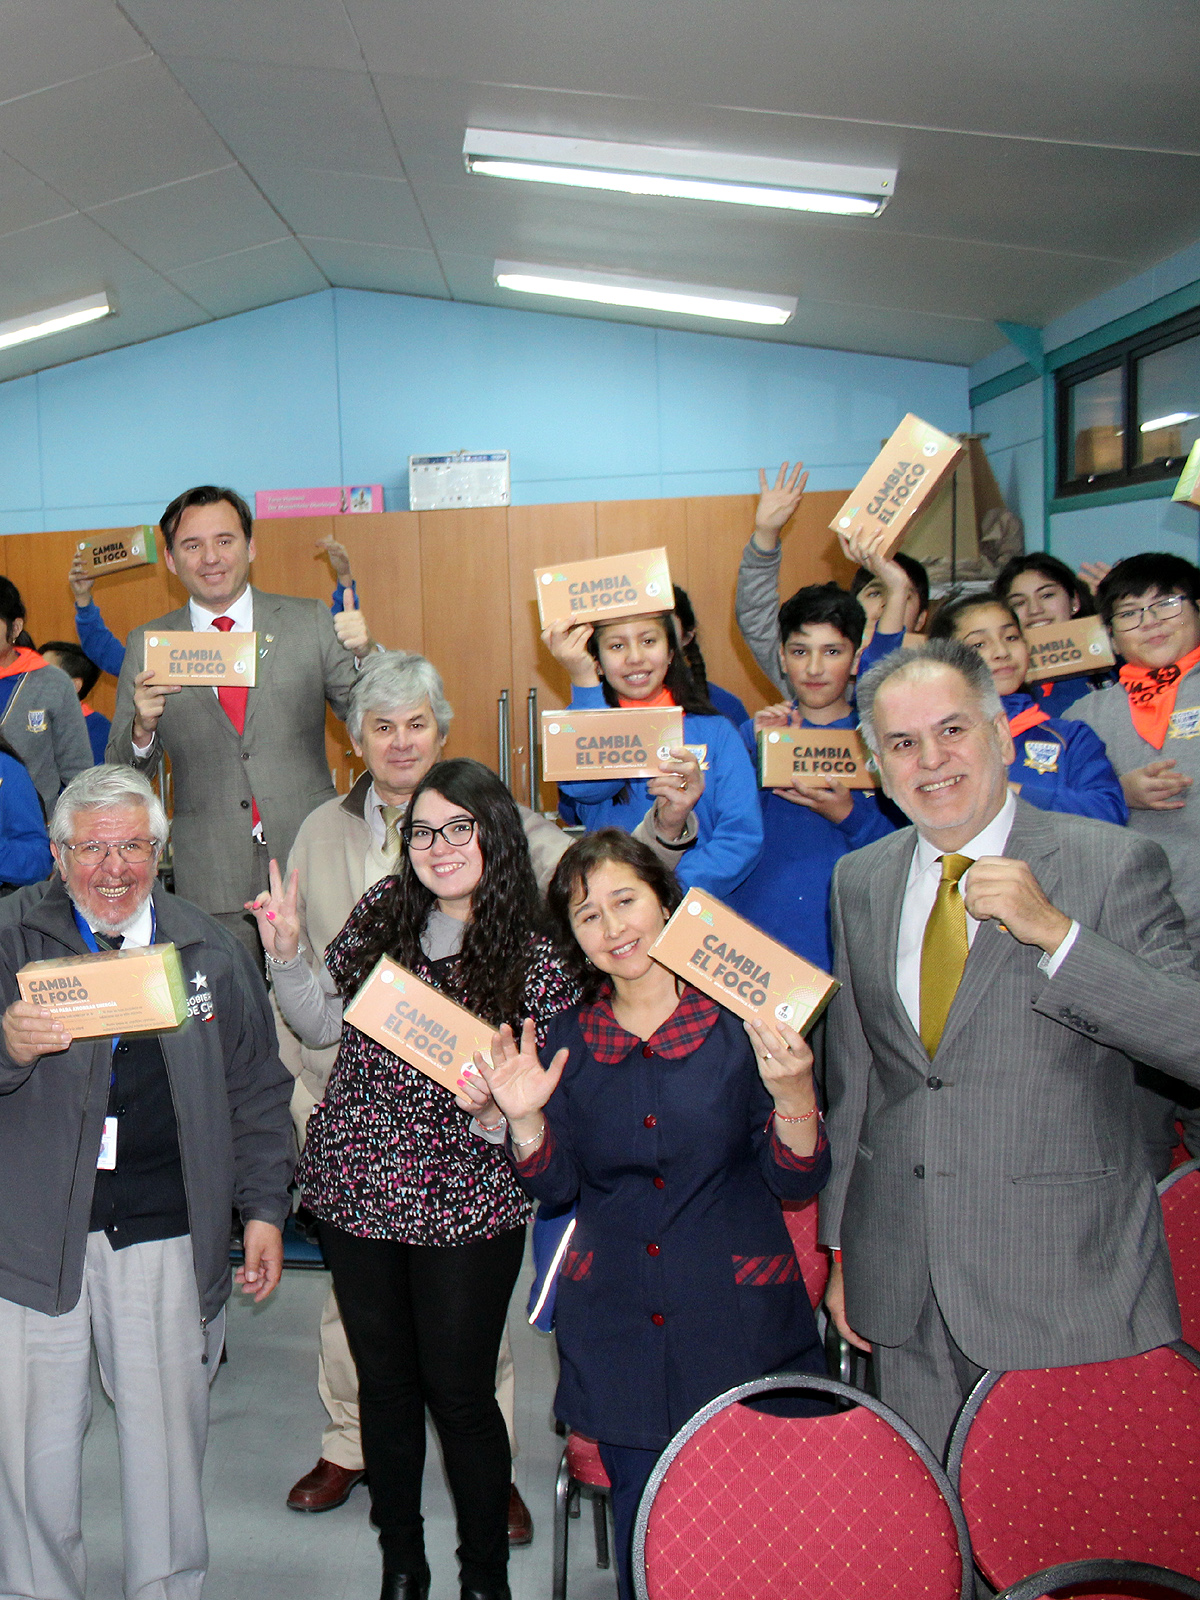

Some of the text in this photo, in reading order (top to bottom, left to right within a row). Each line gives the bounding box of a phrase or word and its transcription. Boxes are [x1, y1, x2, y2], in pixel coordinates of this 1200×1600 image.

[867, 461, 912, 515] CAMBIA
[877, 508, 895, 525] EL
[890, 463, 925, 506] FOCO
[93, 542, 124, 556] CAMBIA
[93, 550, 127, 565] EL FOCO
[568, 575, 631, 595] CAMBIA
[570, 597, 587, 610] EL
[591, 588, 638, 607] FOCO
[1030, 638, 1075, 654] AMBIA
[170, 649, 222, 661] CAMBIA
[1041, 649, 1082, 666] FOCO
[169, 662, 226, 674] EL FOCO
[575, 734, 643, 750] CAMBIA
[576, 749, 647, 765] EL FOCO
[793, 746, 851, 759] CAMBIA
[793, 761, 857, 773] EL FOCO
[703, 934, 771, 989] CAMBIA
[28, 976, 82, 992] CAMBIA
[689, 948, 766, 1006] EL FOCO
[31, 994, 48, 1005] EL
[49, 988, 88, 1002] FOCO
[778, 1011, 788, 1019] LED
[395, 1001, 458, 1050] CAMBIA
[384, 1013, 454, 1066] EL FOCO
